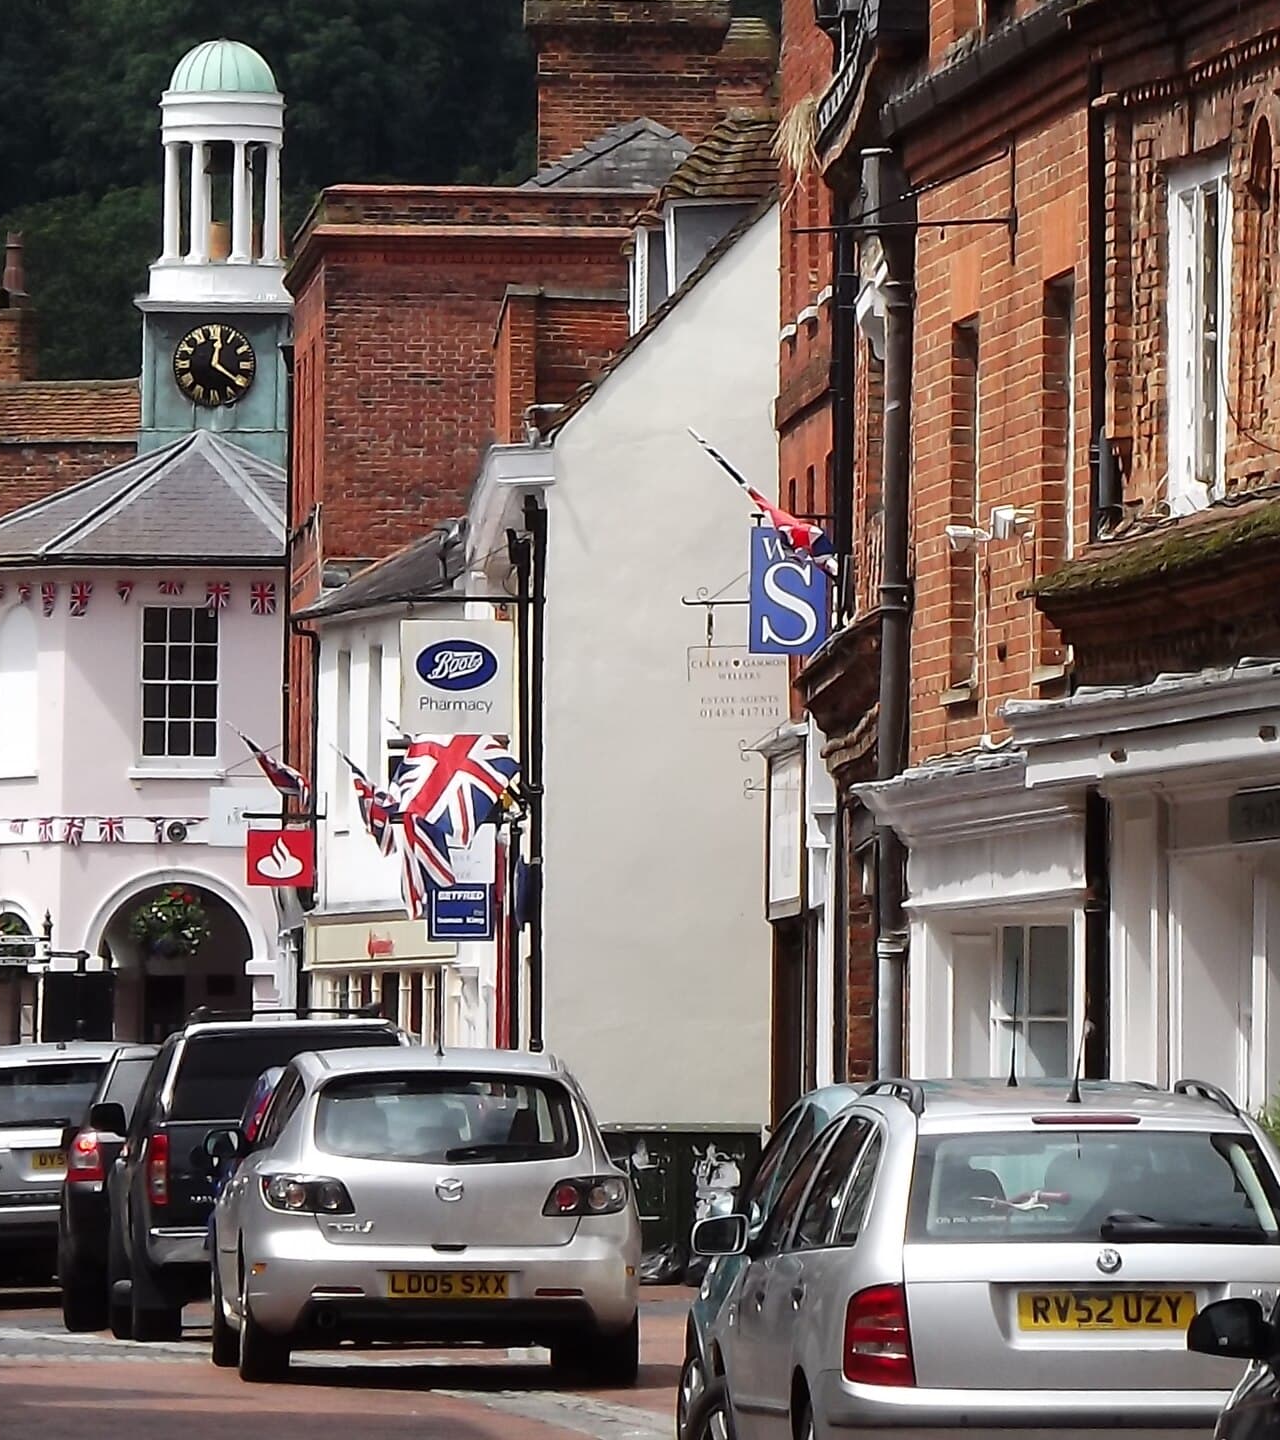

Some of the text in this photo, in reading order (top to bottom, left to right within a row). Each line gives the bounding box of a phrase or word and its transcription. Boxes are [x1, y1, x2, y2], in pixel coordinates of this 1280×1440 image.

[761, 562, 817, 646] S
[427, 650, 483, 679] Boots
[419, 696, 493, 714] Pharmacy
[700, 695, 779, 704] ESTATE AGENTS
[390, 1273, 506, 1295] LD05 SXX
[1031, 1295, 1183, 1325] RV52 UZY
